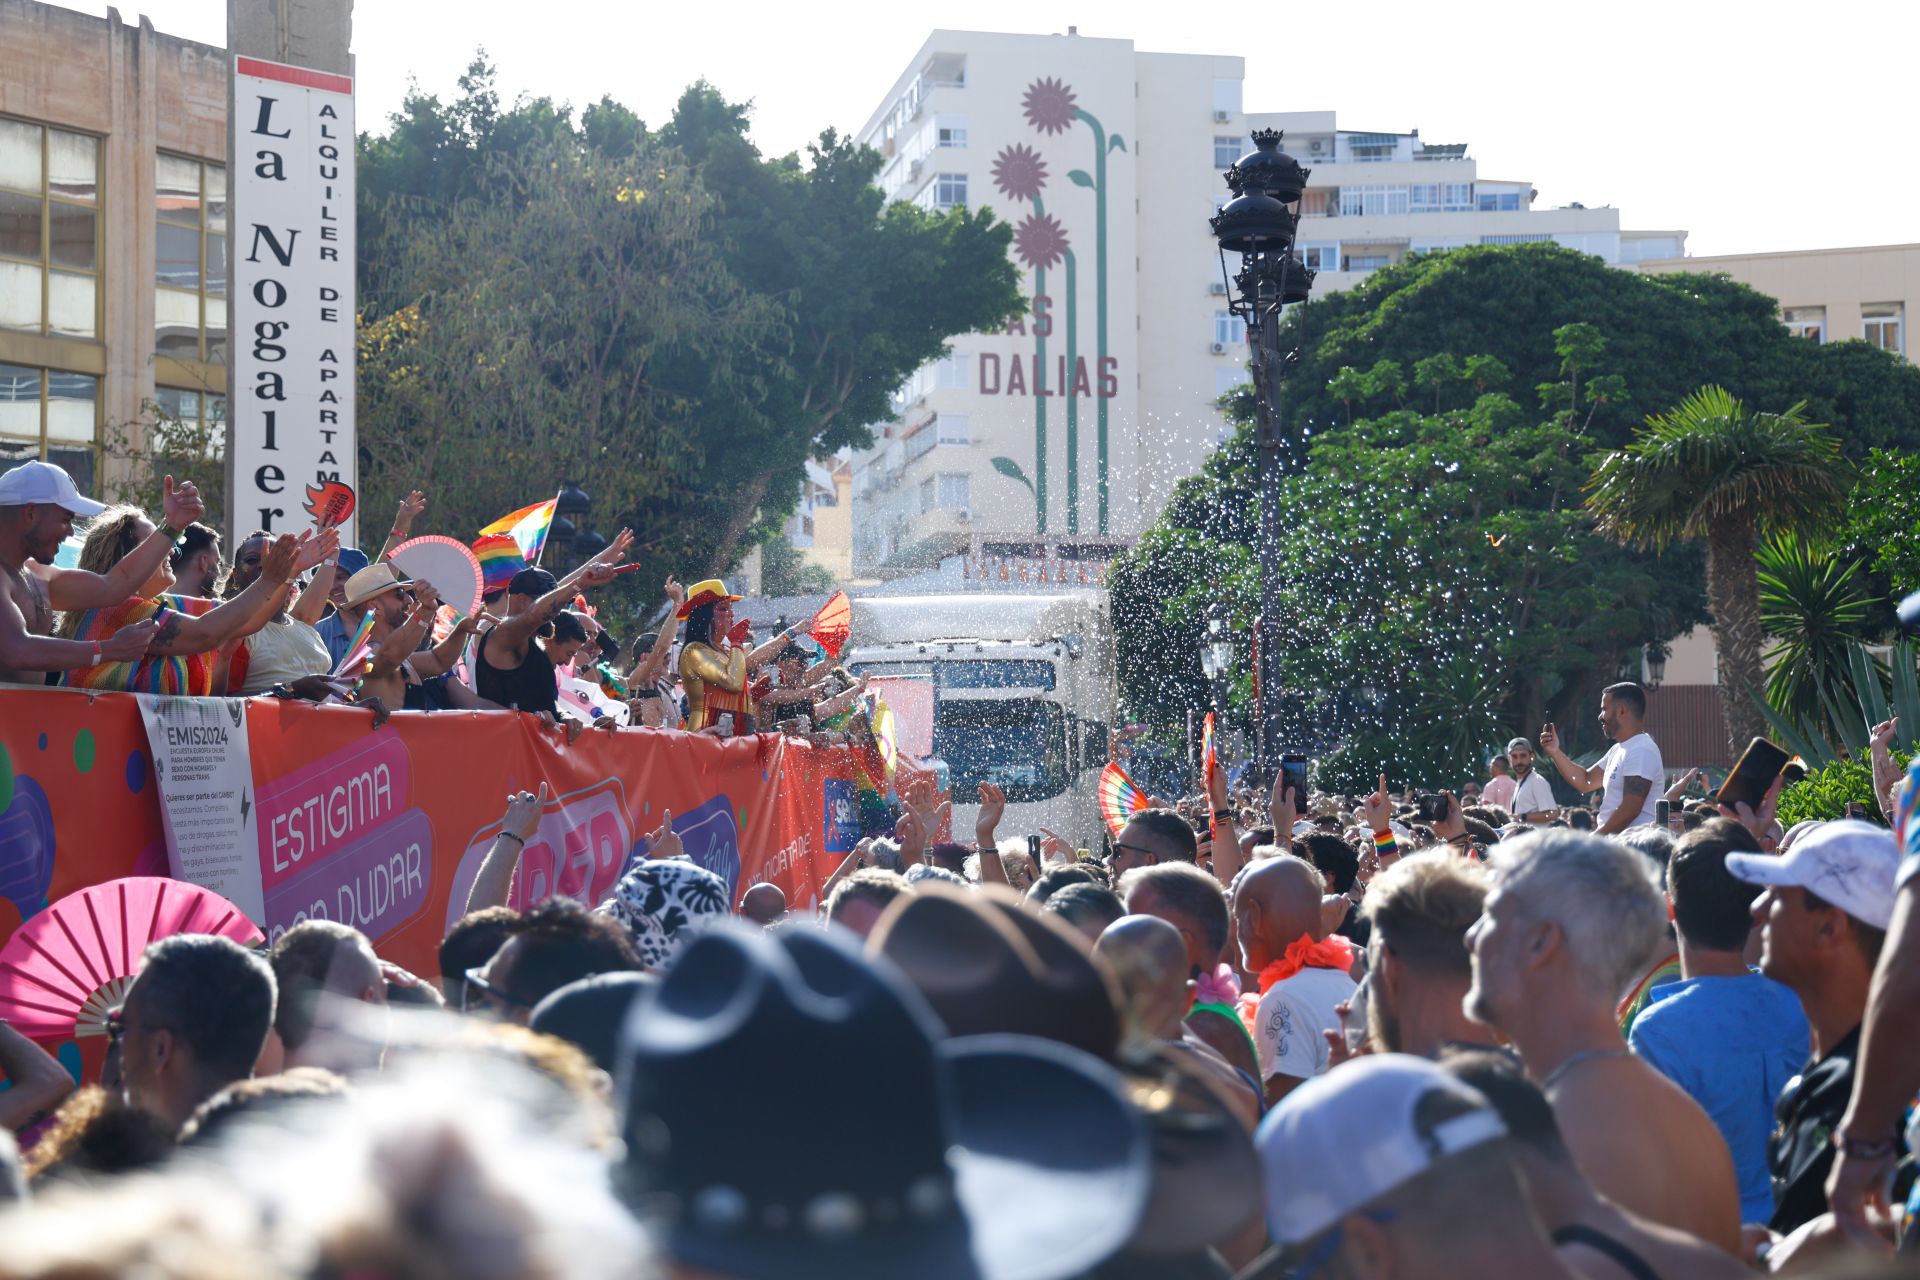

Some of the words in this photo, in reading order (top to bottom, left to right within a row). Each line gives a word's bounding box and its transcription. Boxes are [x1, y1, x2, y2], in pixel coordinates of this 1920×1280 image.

[250, 95, 292, 182] La
[318, 103, 339, 262] ALQUILER
[319, 287, 339, 322] DE
[979, 352, 1118, 398] DALIAS
[317, 348, 340, 484] APARTAM
[167, 726, 229, 746] EMIS2024
[171, 774, 195, 782] PERSONAS
[196, 792, 209, 802] parte
[271, 762, 392, 874] ESTIGMA
[337, 842, 423, 927] DUDAR
